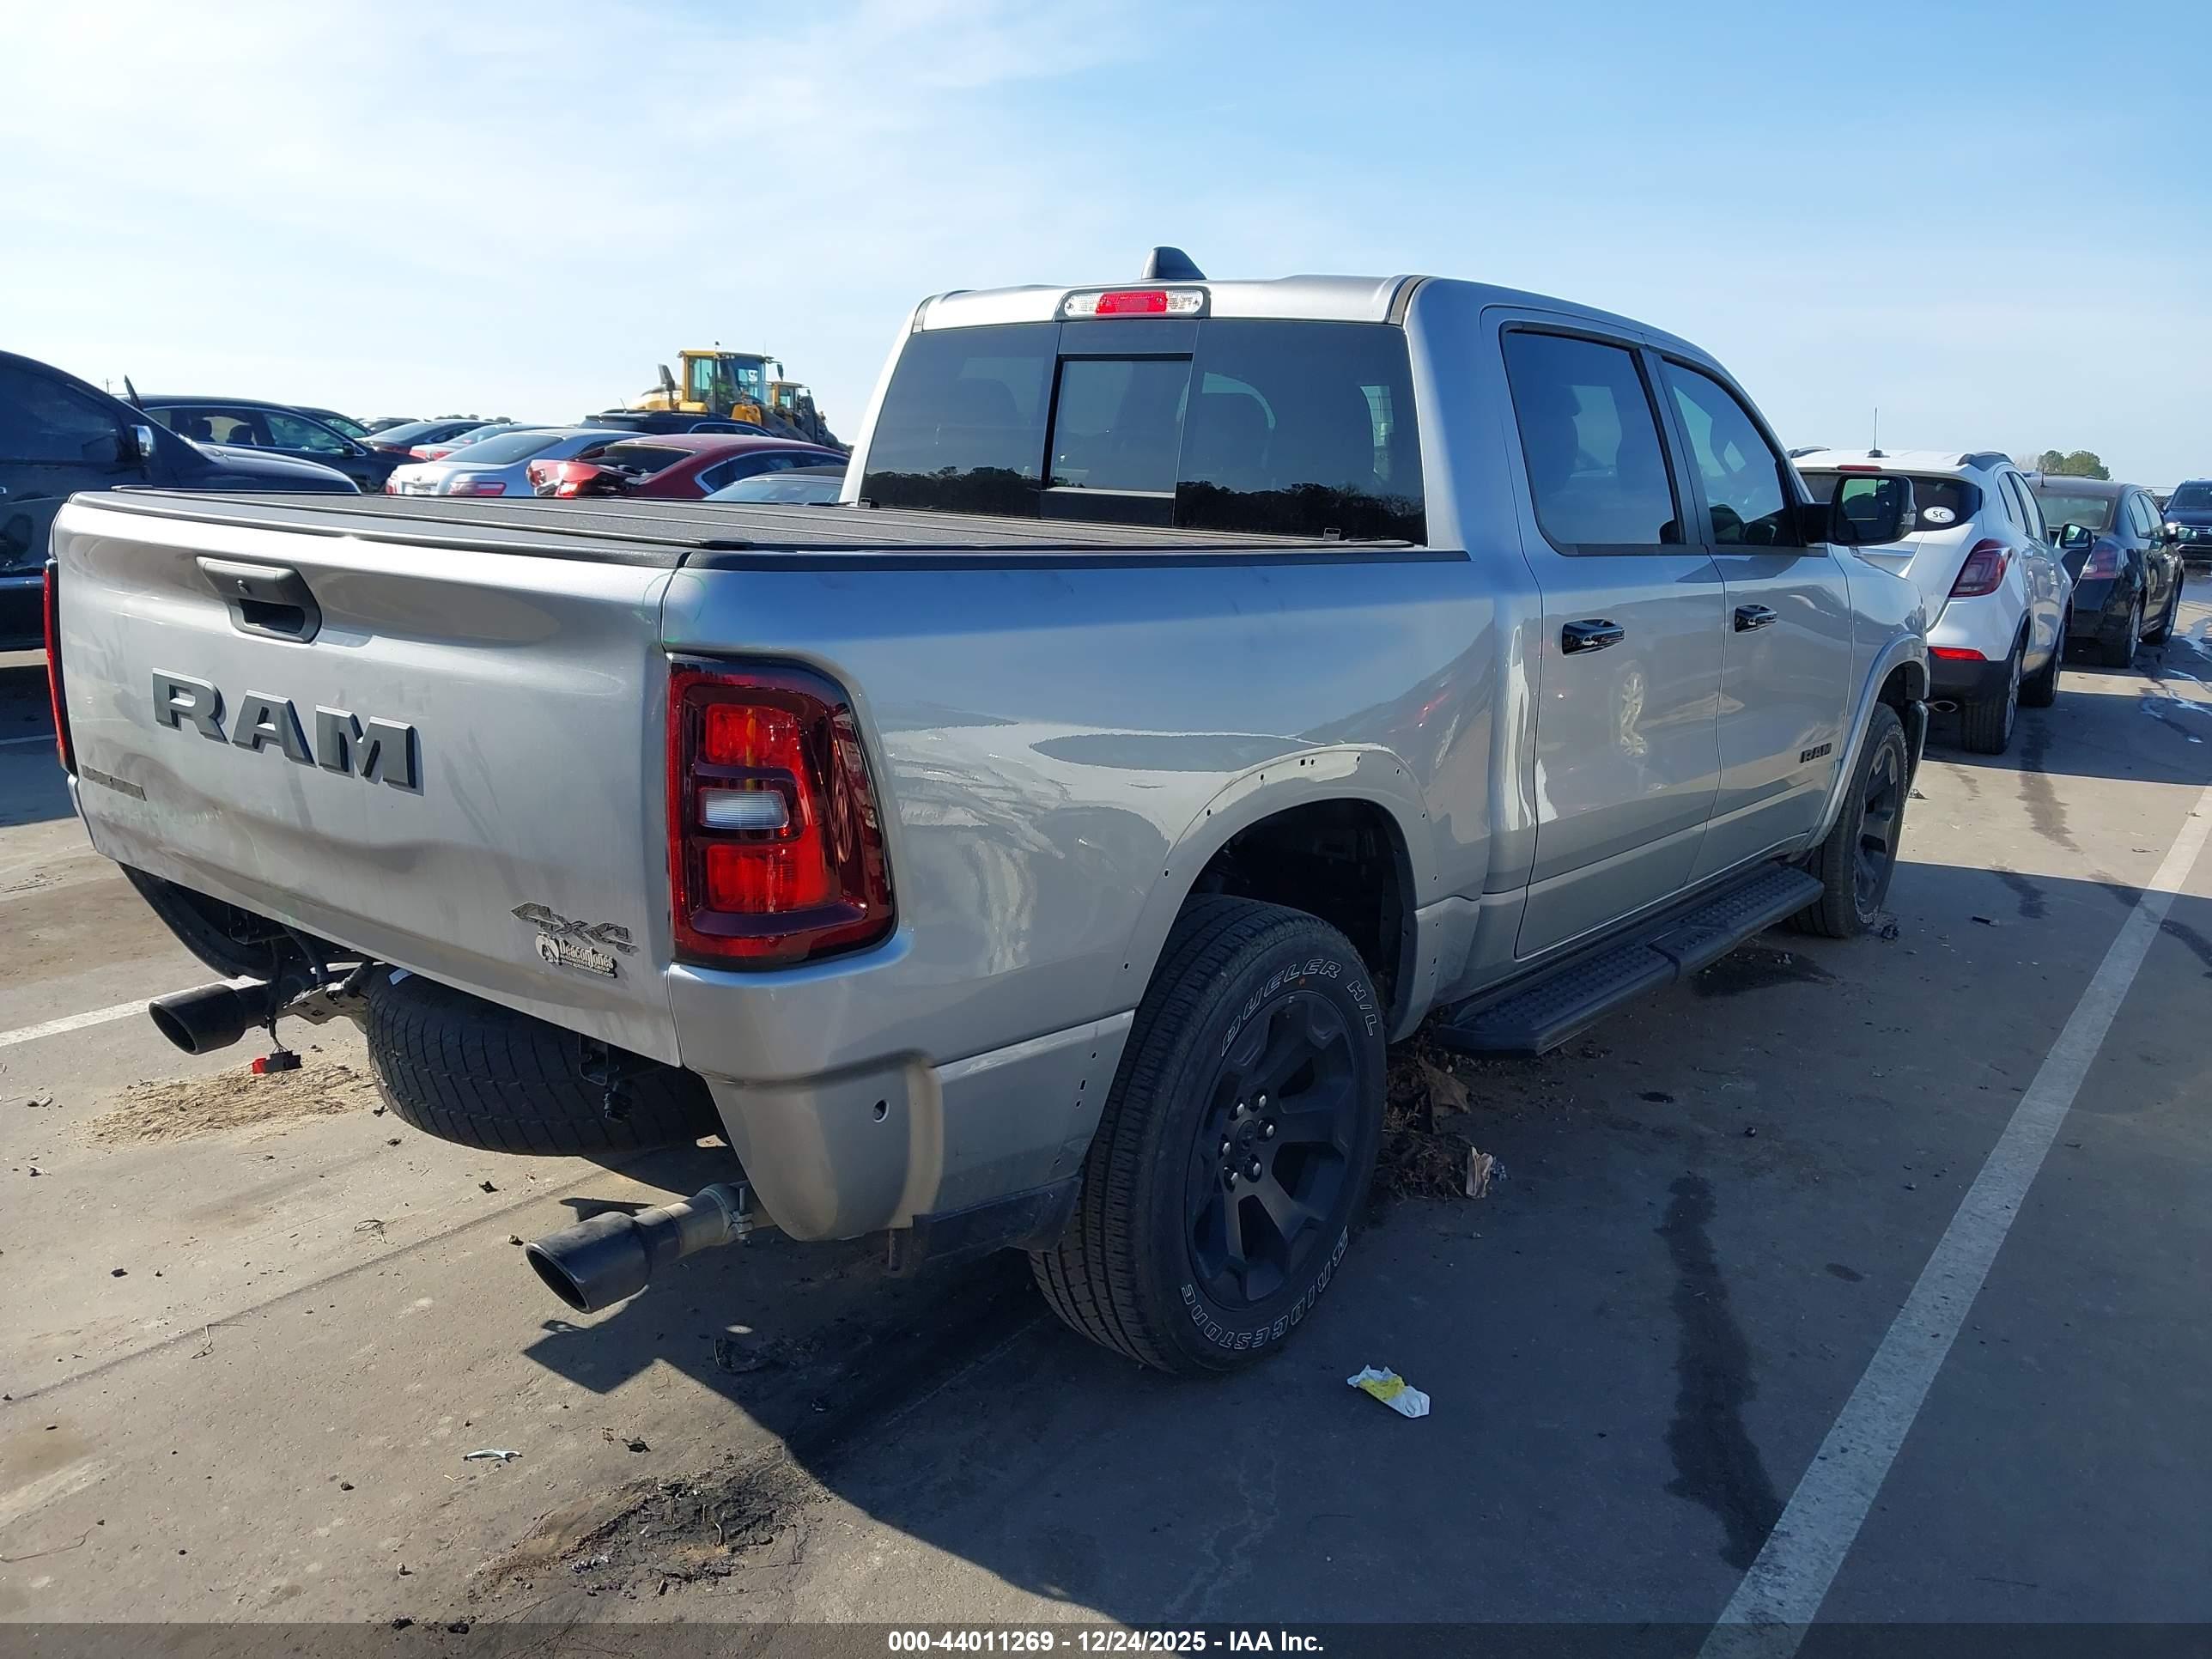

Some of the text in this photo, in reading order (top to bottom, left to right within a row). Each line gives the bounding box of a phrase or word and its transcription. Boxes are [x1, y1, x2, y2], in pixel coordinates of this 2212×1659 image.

[1932, 510, 1947, 520] SC
[152, 667, 419, 790] RAM
[1799, 742, 1832, 763] RAM
[1221, 958, 1342, 1057] DUELER
[1181, 1224, 1348, 1350] BRIDGESTONE
